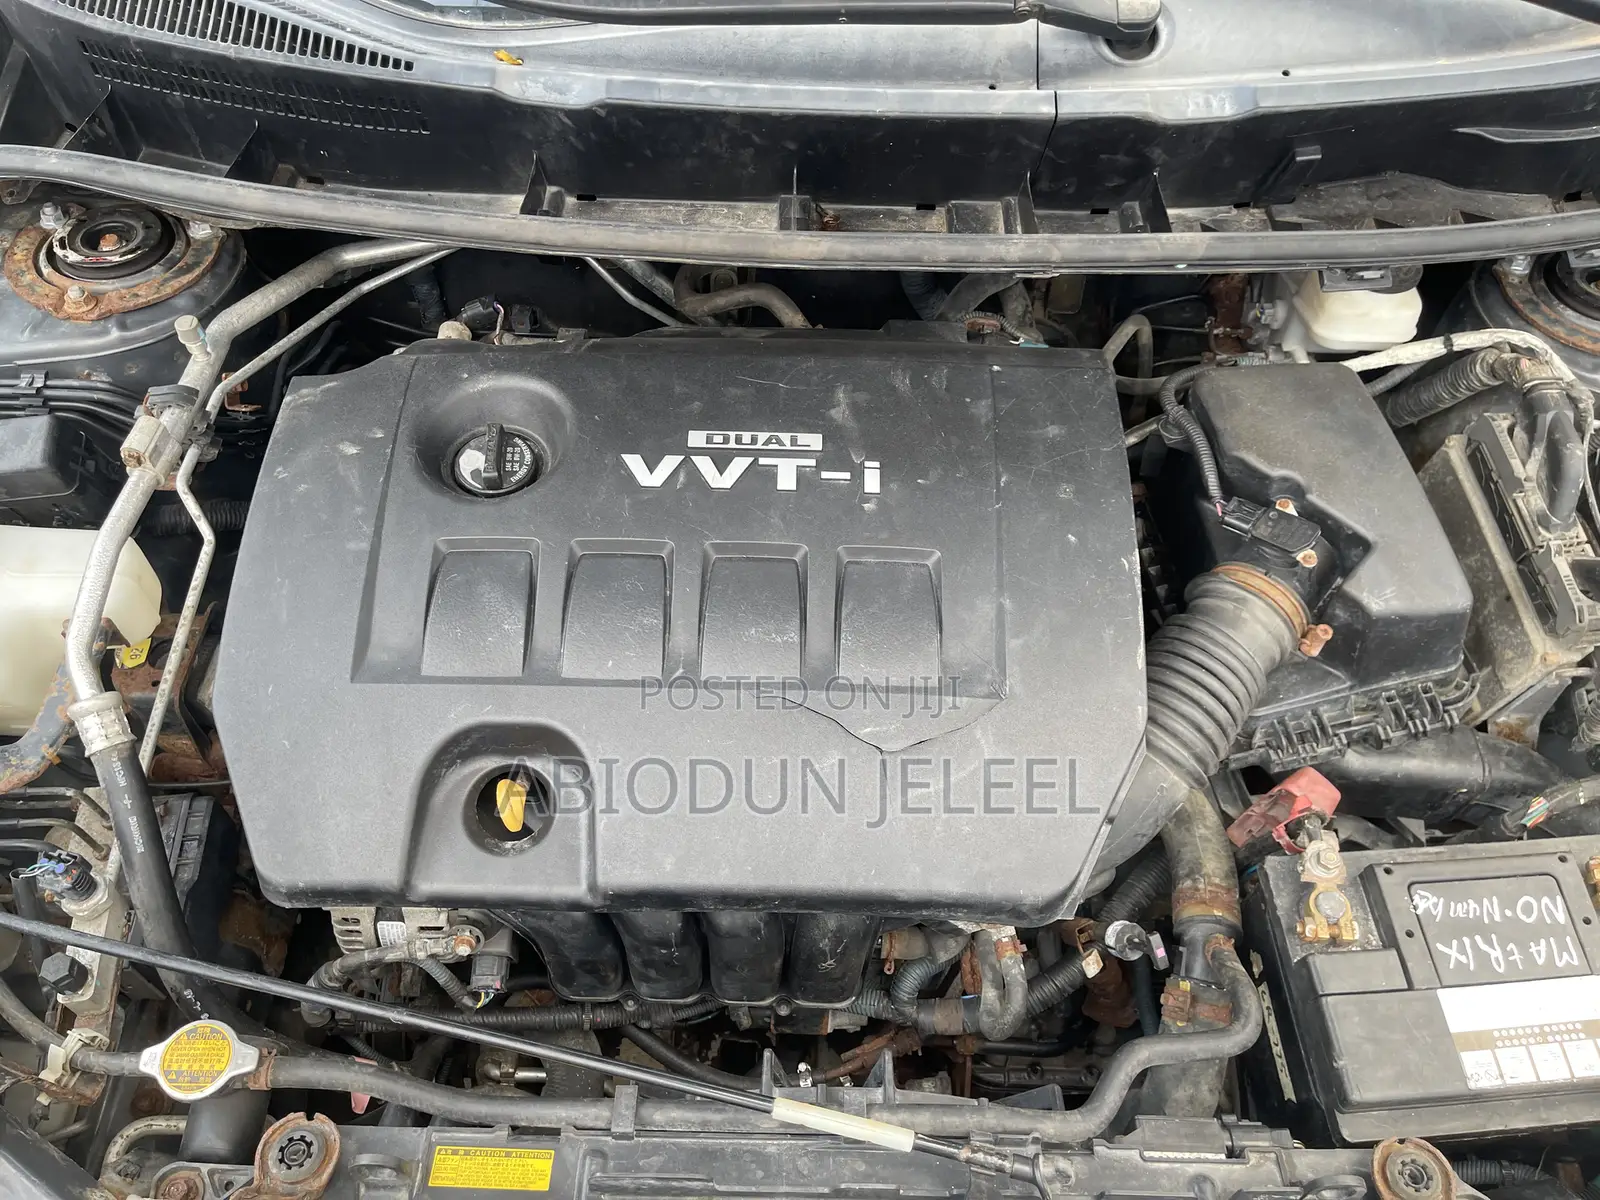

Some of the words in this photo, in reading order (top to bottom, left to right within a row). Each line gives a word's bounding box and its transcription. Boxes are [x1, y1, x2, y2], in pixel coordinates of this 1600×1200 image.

[704, 431, 813, 449] DUAL
[510, 465, 528, 482] ENERGY
[620, 453, 881, 494] VVT-i
[511, 1151, 551, 1159] ATTENTION
